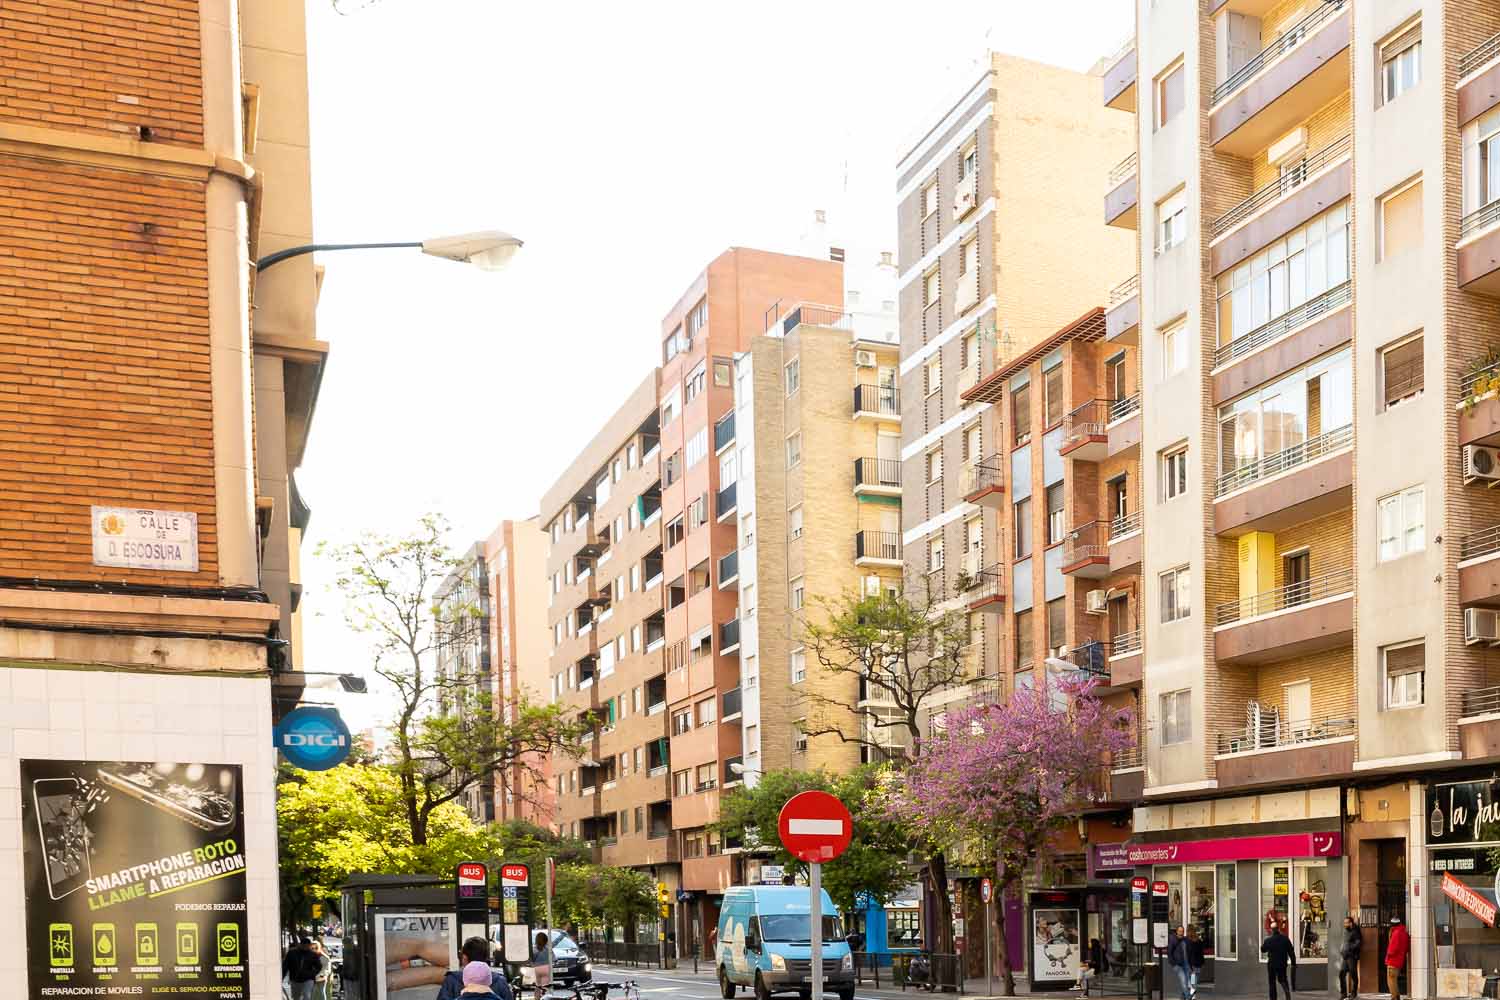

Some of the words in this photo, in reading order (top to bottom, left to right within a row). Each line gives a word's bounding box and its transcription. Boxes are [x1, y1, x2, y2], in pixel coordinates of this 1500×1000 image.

[141, 516, 179, 530] CALLE
[156, 530, 166, 539] DE
[123, 542, 182, 560] ESCOSURA
[283, 734, 346, 747] DIGI
[1450, 787, 1467, 832] la
[86, 851, 195, 895] SMARTPHONE
[193, 839, 237, 863] ROTO
[88, 882, 146, 911] LLAME
[150, 879, 160, 893] A
[161, 854, 245, 889] REPARACION
[503, 887, 517, 898] 35
[175, 903, 212, 911] PODEMOS
[213, 903, 246, 911] REPARAR
[384, 917, 449, 931] LOEWE
[41, 987, 93, 995] REPARACION
[95, 987, 107, 995] DE
[107, 986, 143, 994] MOVILES
